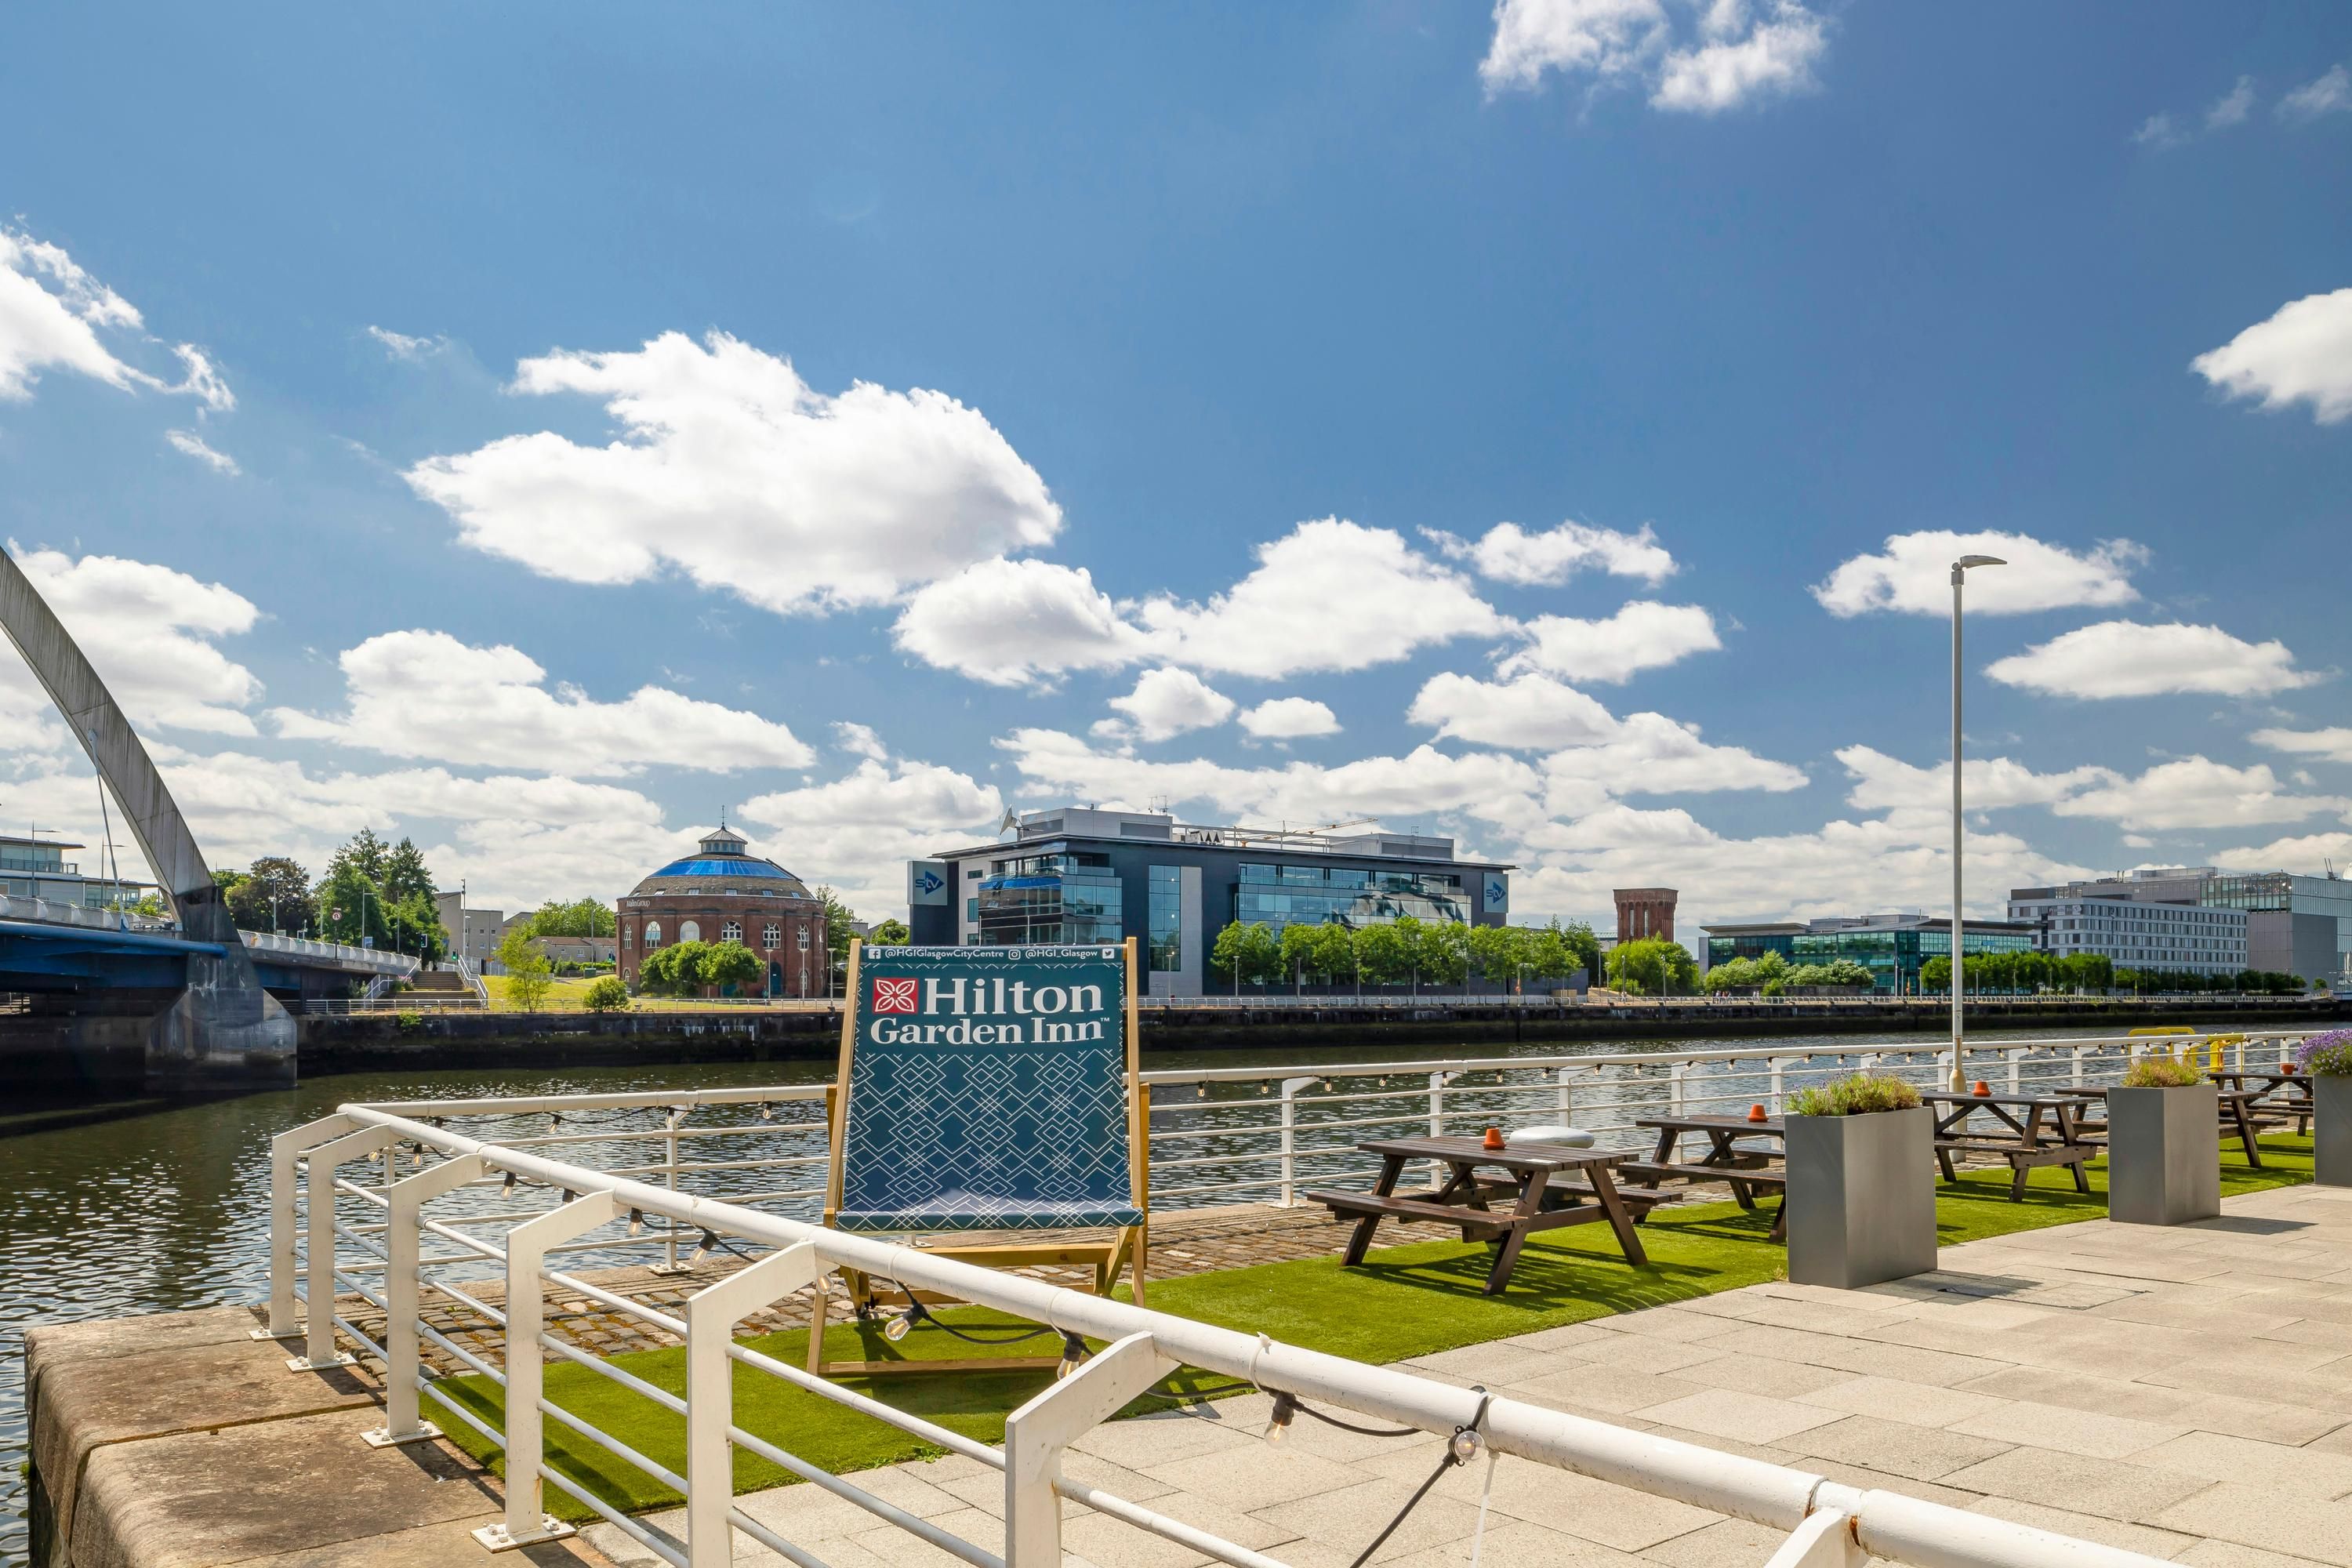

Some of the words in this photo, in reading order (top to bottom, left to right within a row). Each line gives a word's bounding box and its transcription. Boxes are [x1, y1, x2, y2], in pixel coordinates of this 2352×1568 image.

[916, 877, 940, 889] stv
[637, 899, 651, 909] Group
[884, 948, 1004, 960] @HGIGlasgowCityCentre
[1025, 949, 1098, 960] @HGI_Glasgow
[923, 978, 1104, 1015] Hilton
[870, 1018, 1025, 1045] Garden
